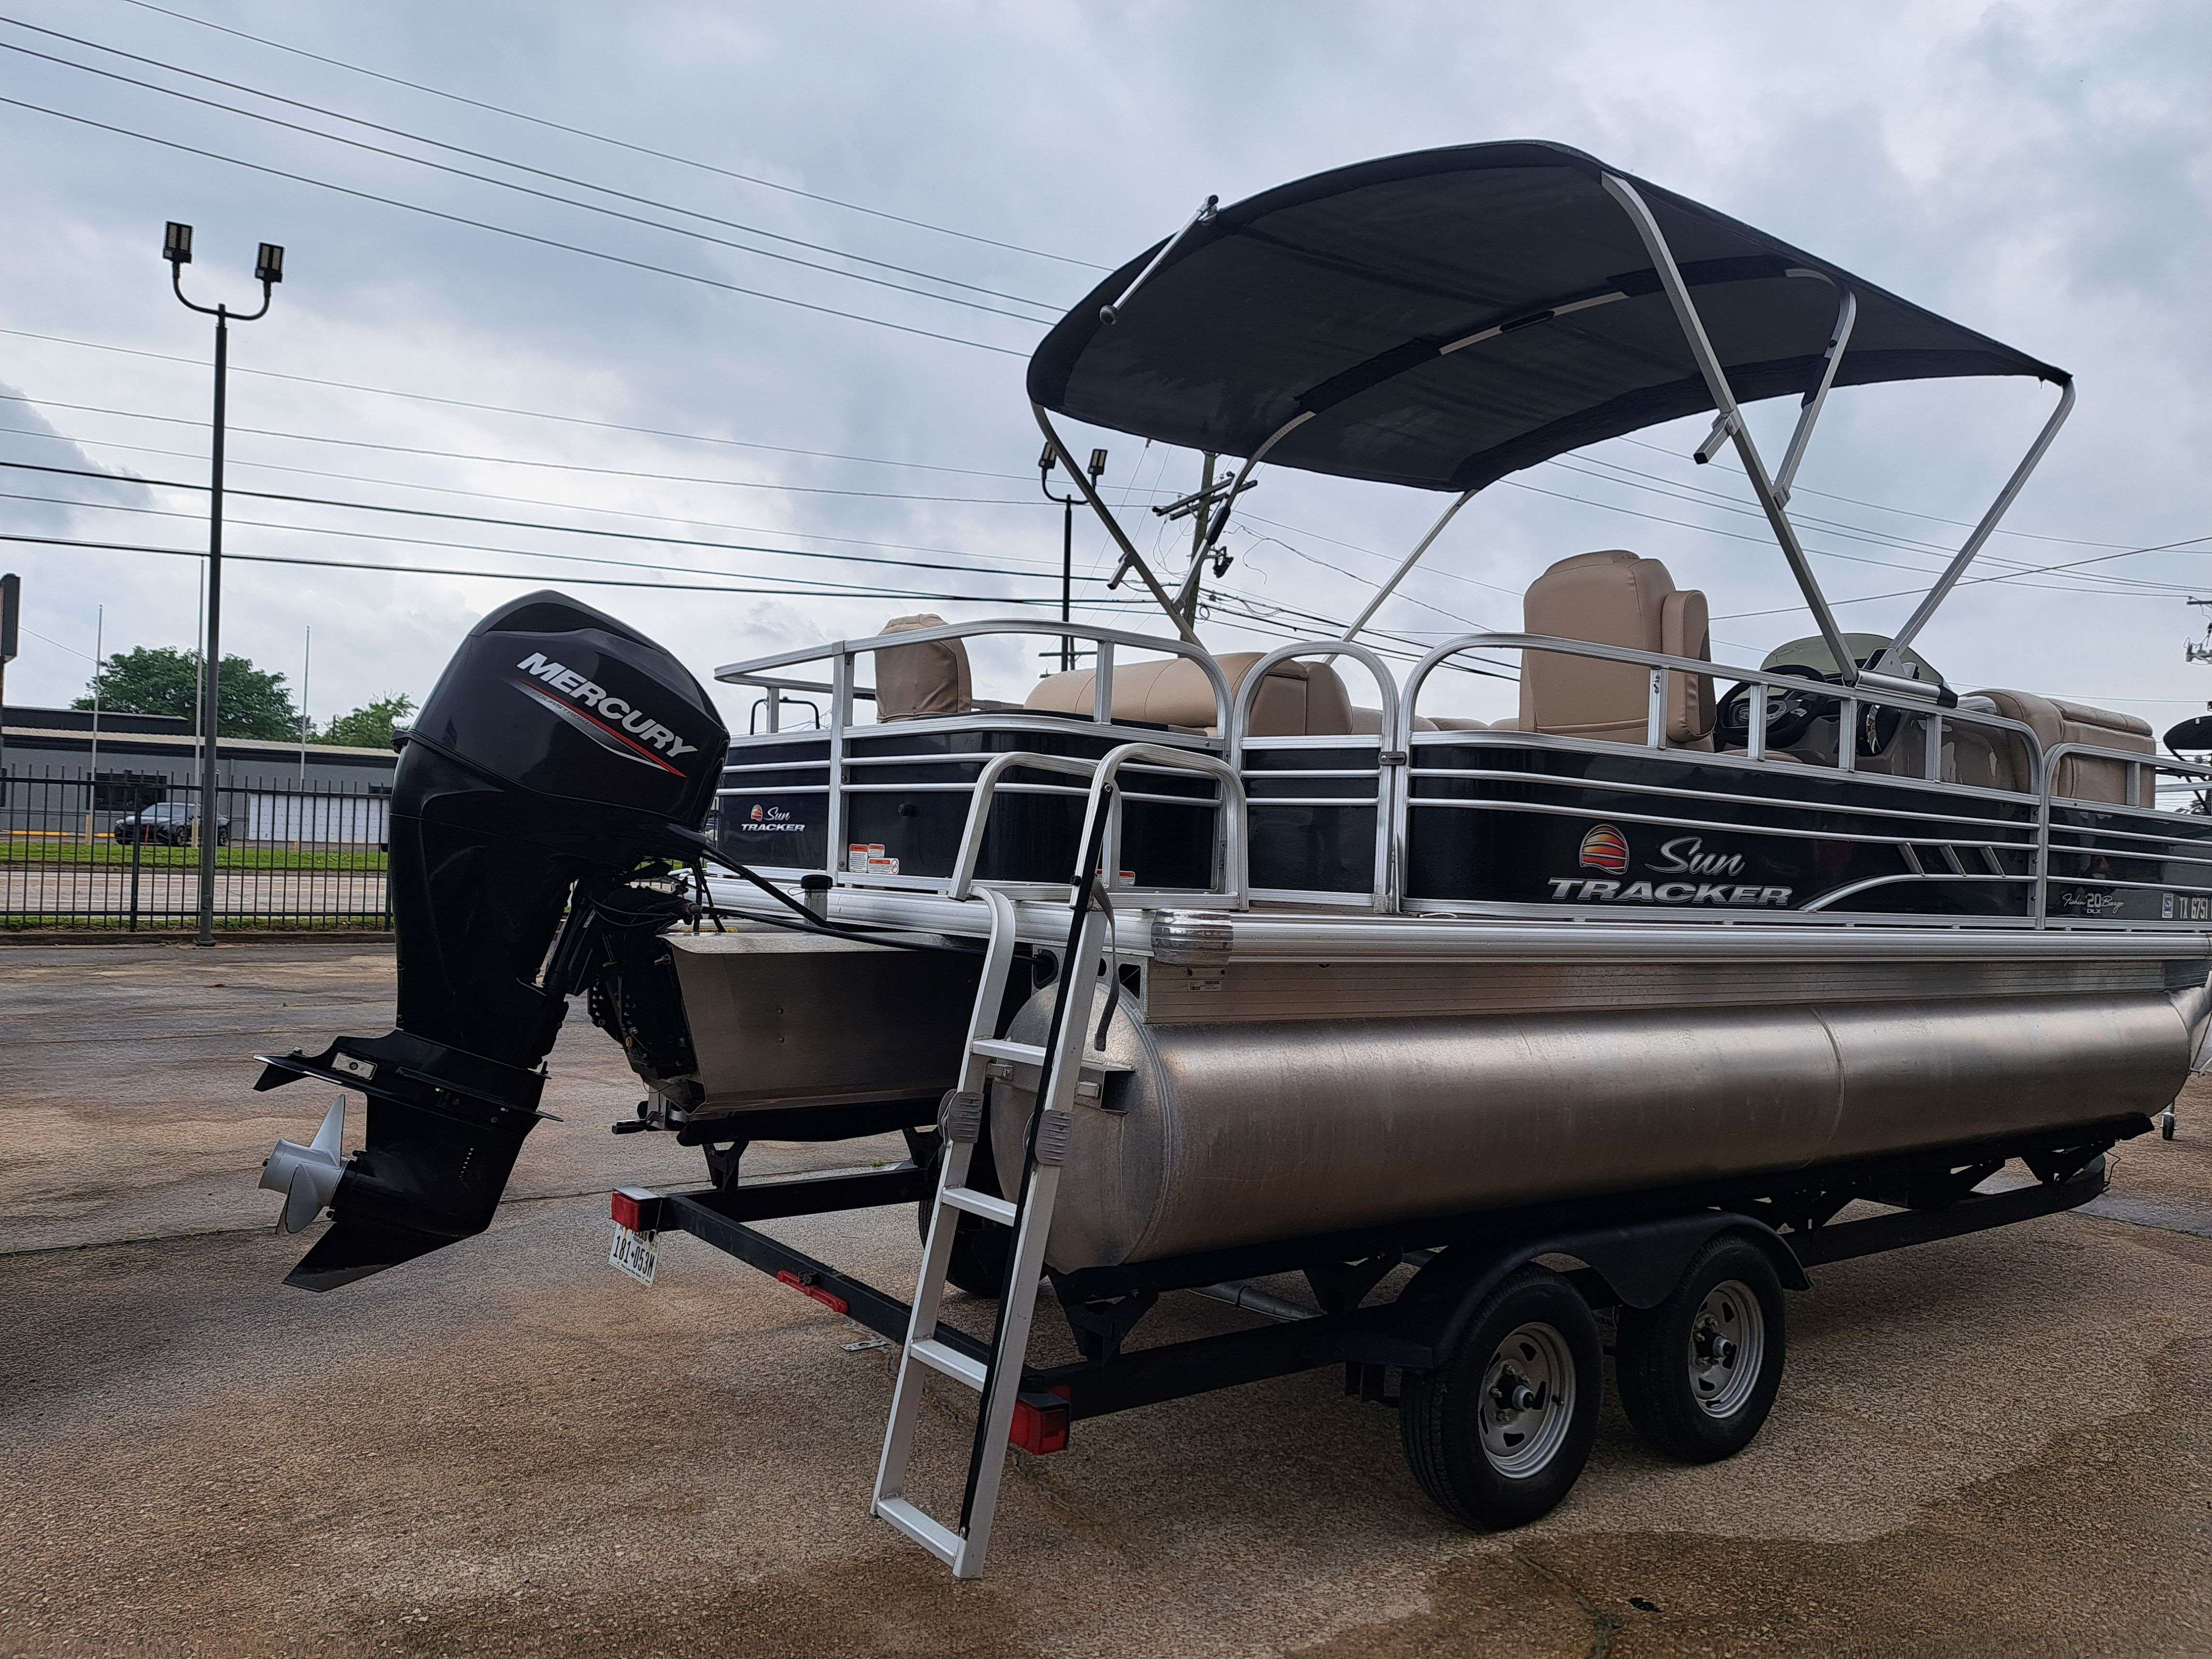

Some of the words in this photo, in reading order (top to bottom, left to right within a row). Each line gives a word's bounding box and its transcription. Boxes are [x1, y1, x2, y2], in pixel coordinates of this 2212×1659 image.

[517, 653, 698, 758] MERCURY
[531, 690, 590, 727] FOURSTROKE
[763, 806, 790, 821] Sun
[741, 823, 805, 831] TRACKER
[1644, 836, 1746, 876] Sun
[1547, 877, 1793, 906] TRACKER
[2087, 893, 2102, 908] 20
[2179, 897, 2188, 919] TX
